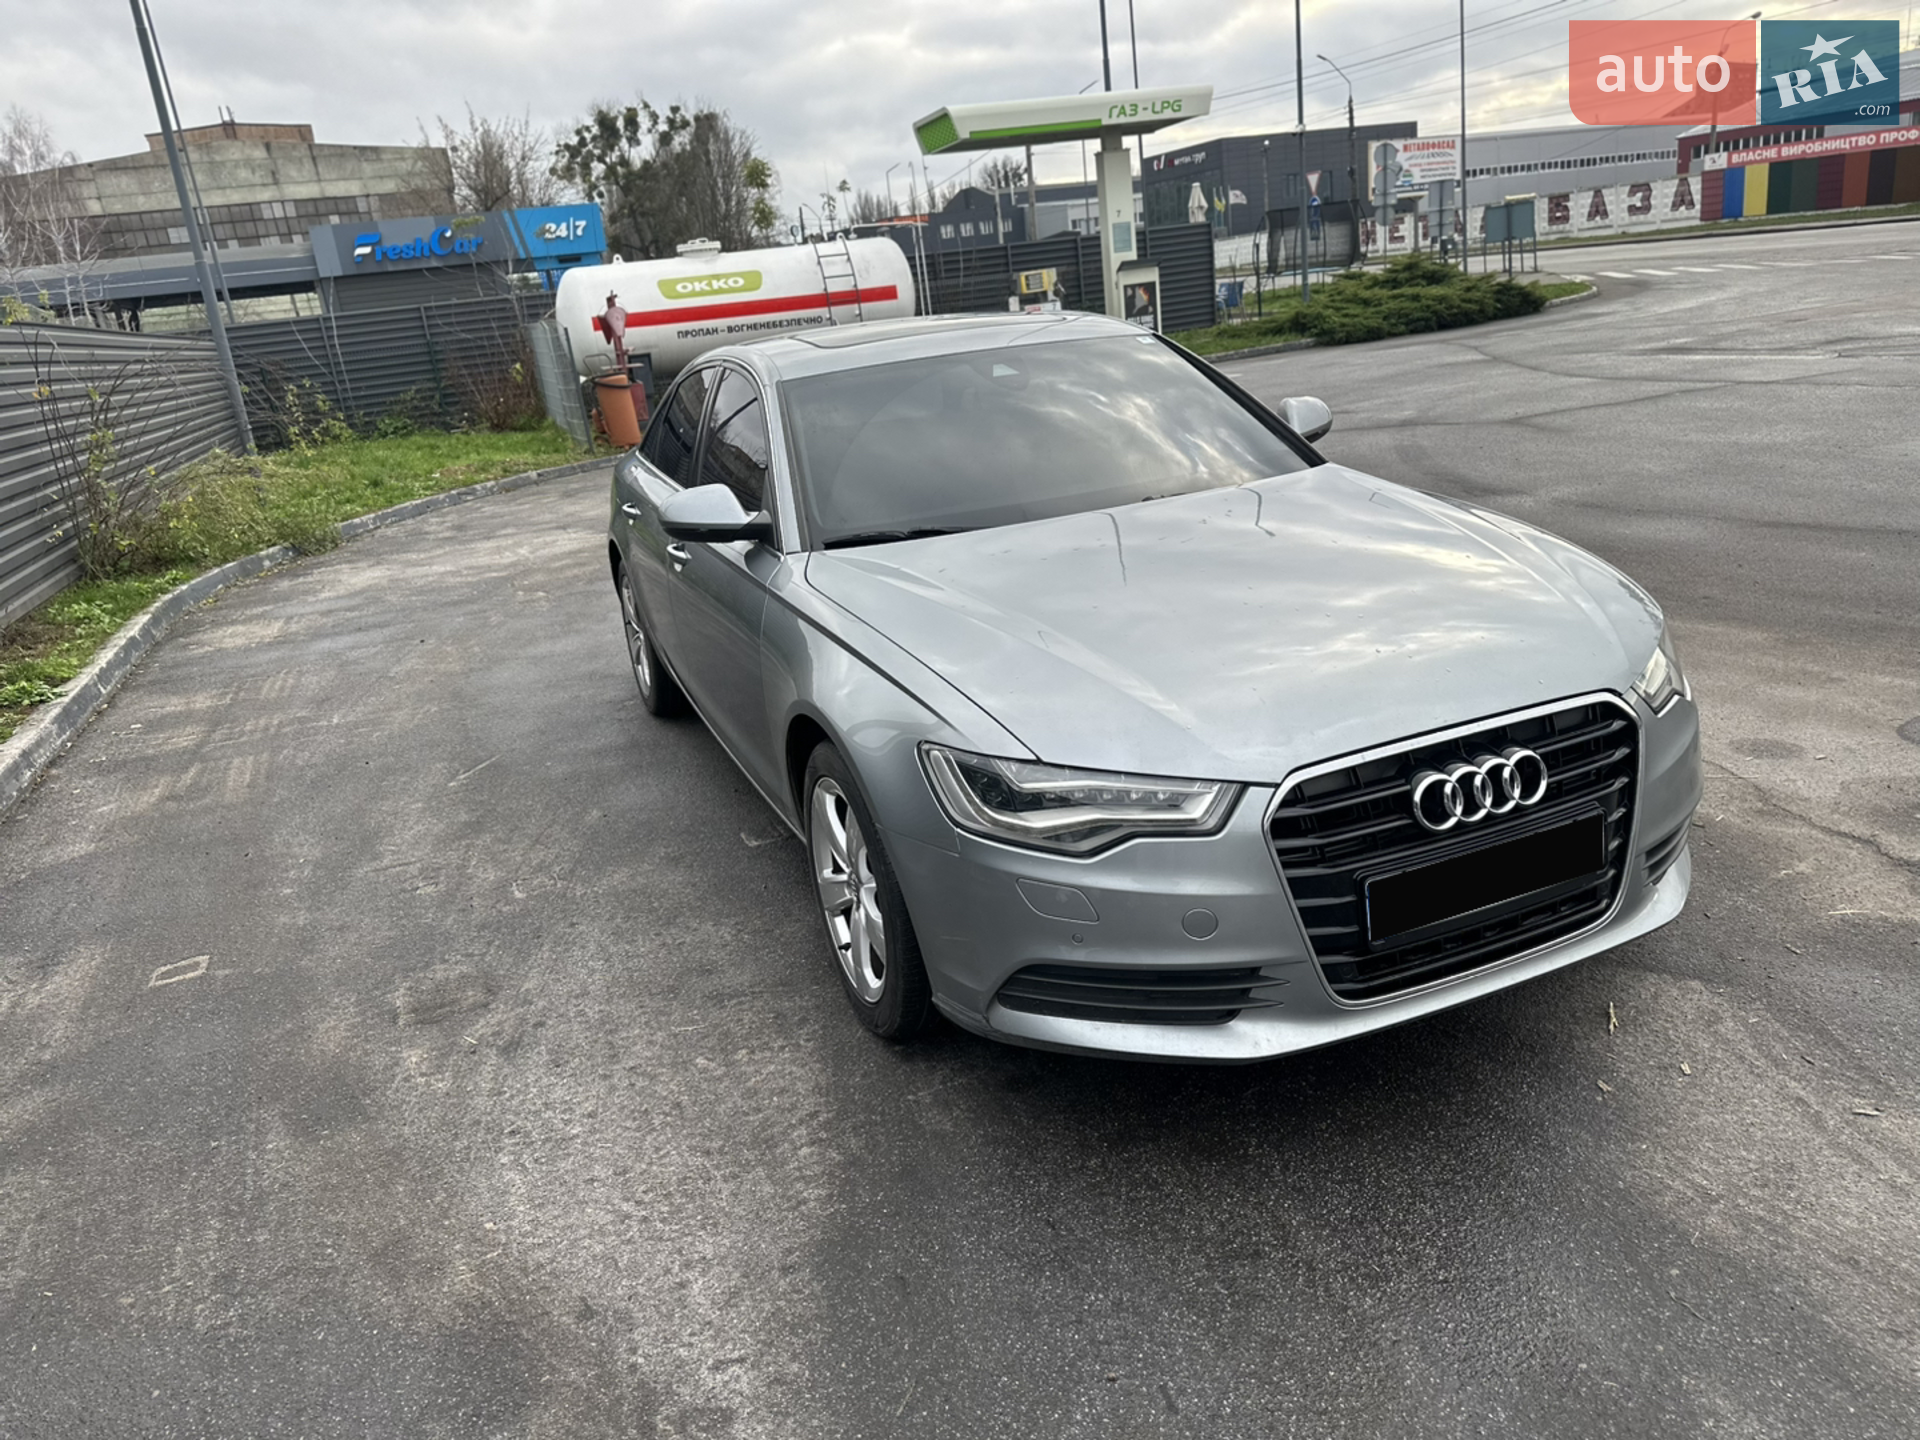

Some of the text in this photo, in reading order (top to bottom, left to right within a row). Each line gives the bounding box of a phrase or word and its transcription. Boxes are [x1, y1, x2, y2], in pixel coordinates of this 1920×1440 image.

[1108, 103, 1139, 119] ГАЗ
[1151, 99, 1183, 114] LPG
[1731, 129, 1920, 164] ВЛАСНЕ ВИРОБНИЦТВО ПРОФ
[1547, 177, 1696, 226] БАЗА
[354, 226, 484, 263] FreshCar
[676, 277, 745, 293] OKKO
[677, 327, 719, 339] ПРОПАН
